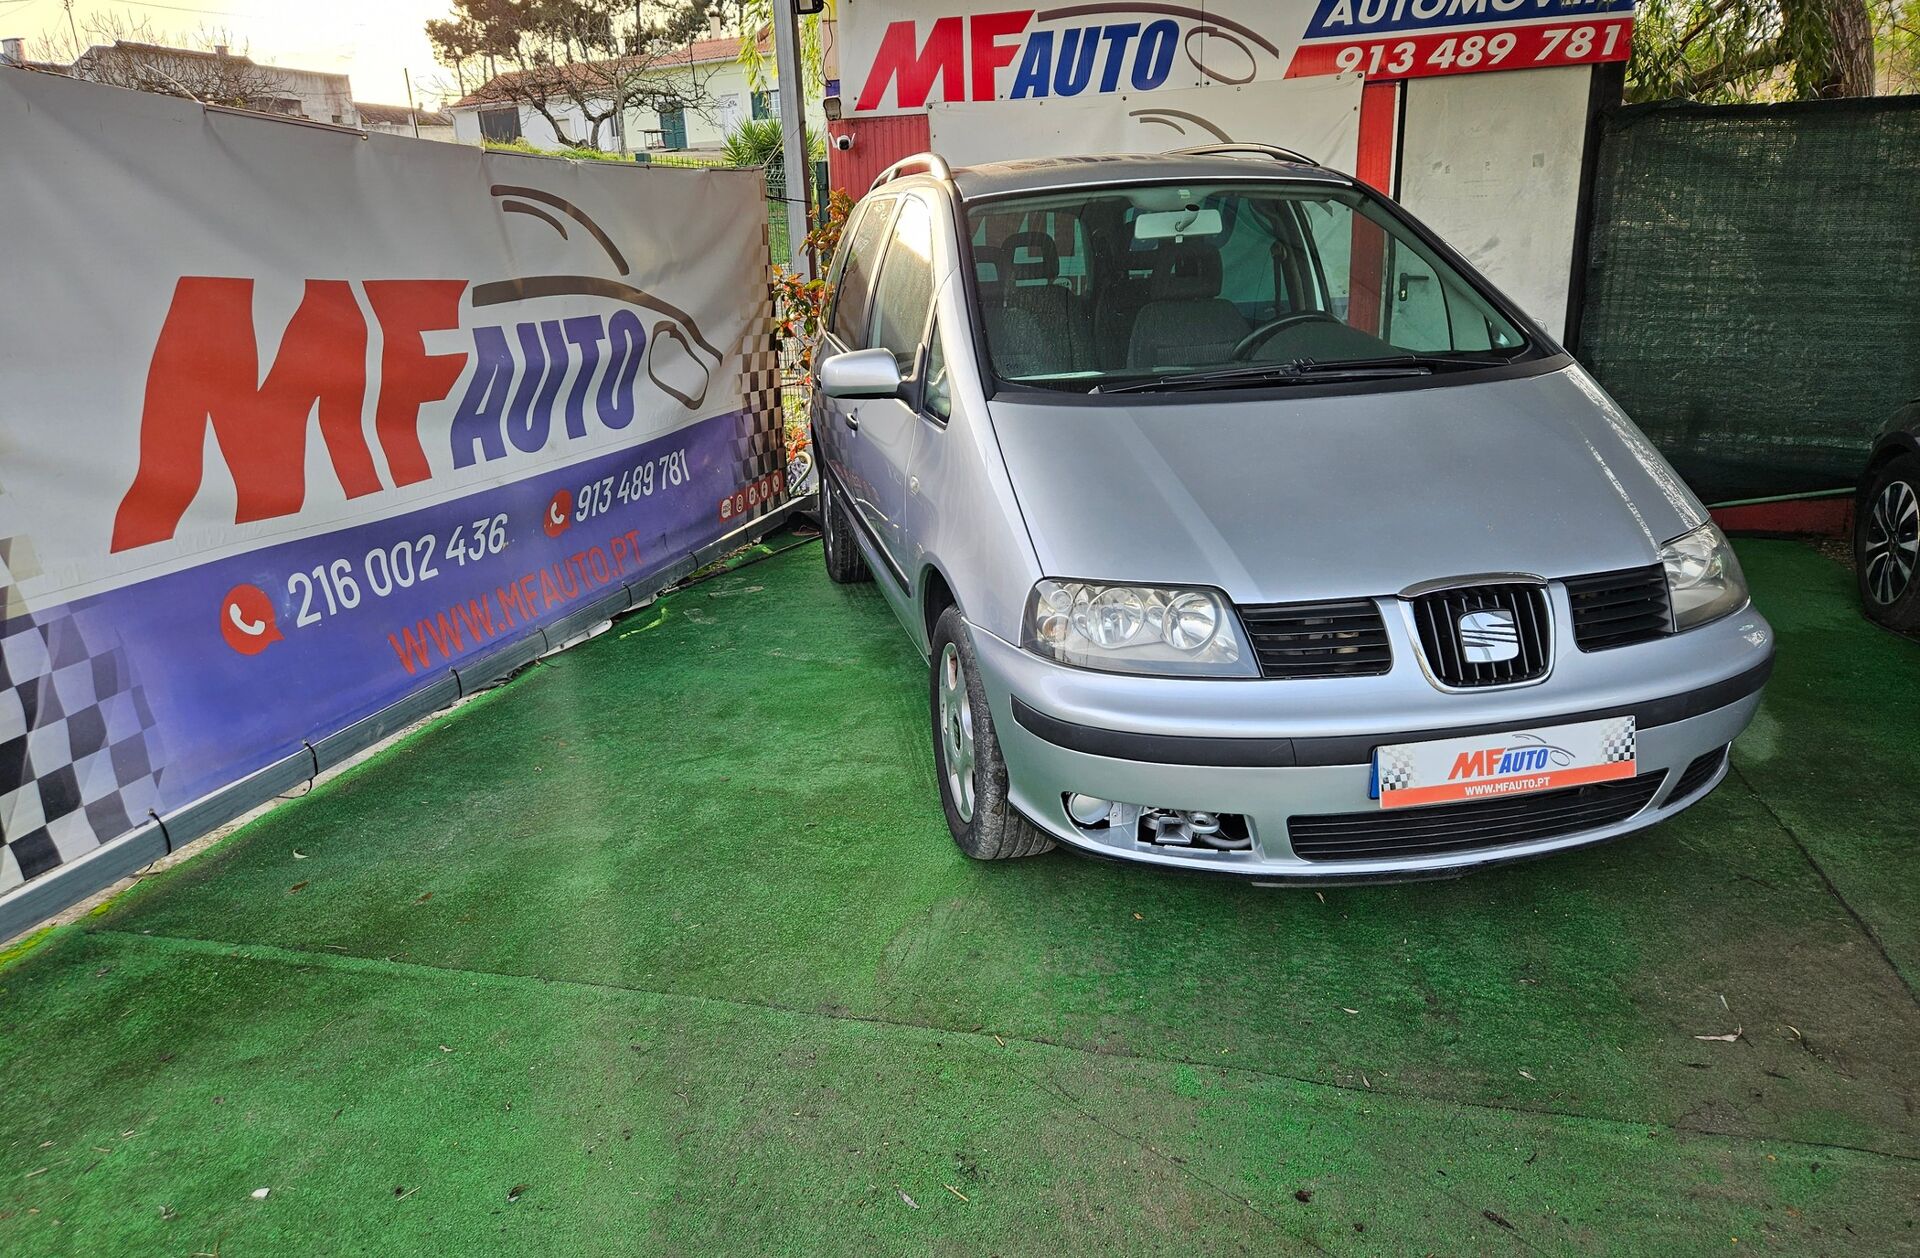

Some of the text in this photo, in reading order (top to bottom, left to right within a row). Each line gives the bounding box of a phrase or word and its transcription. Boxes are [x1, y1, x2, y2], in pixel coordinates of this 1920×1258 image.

[1336, 24, 1622, 75] 913 489 781
[575, 448, 691, 522] 913 489 781
[287, 513, 508, 628] 216 002 436
[388, 529, 644, 675] WWW.MFAUTO.PT
[1465, 776, 1550, 796] WWW.MFAUTO.PT
